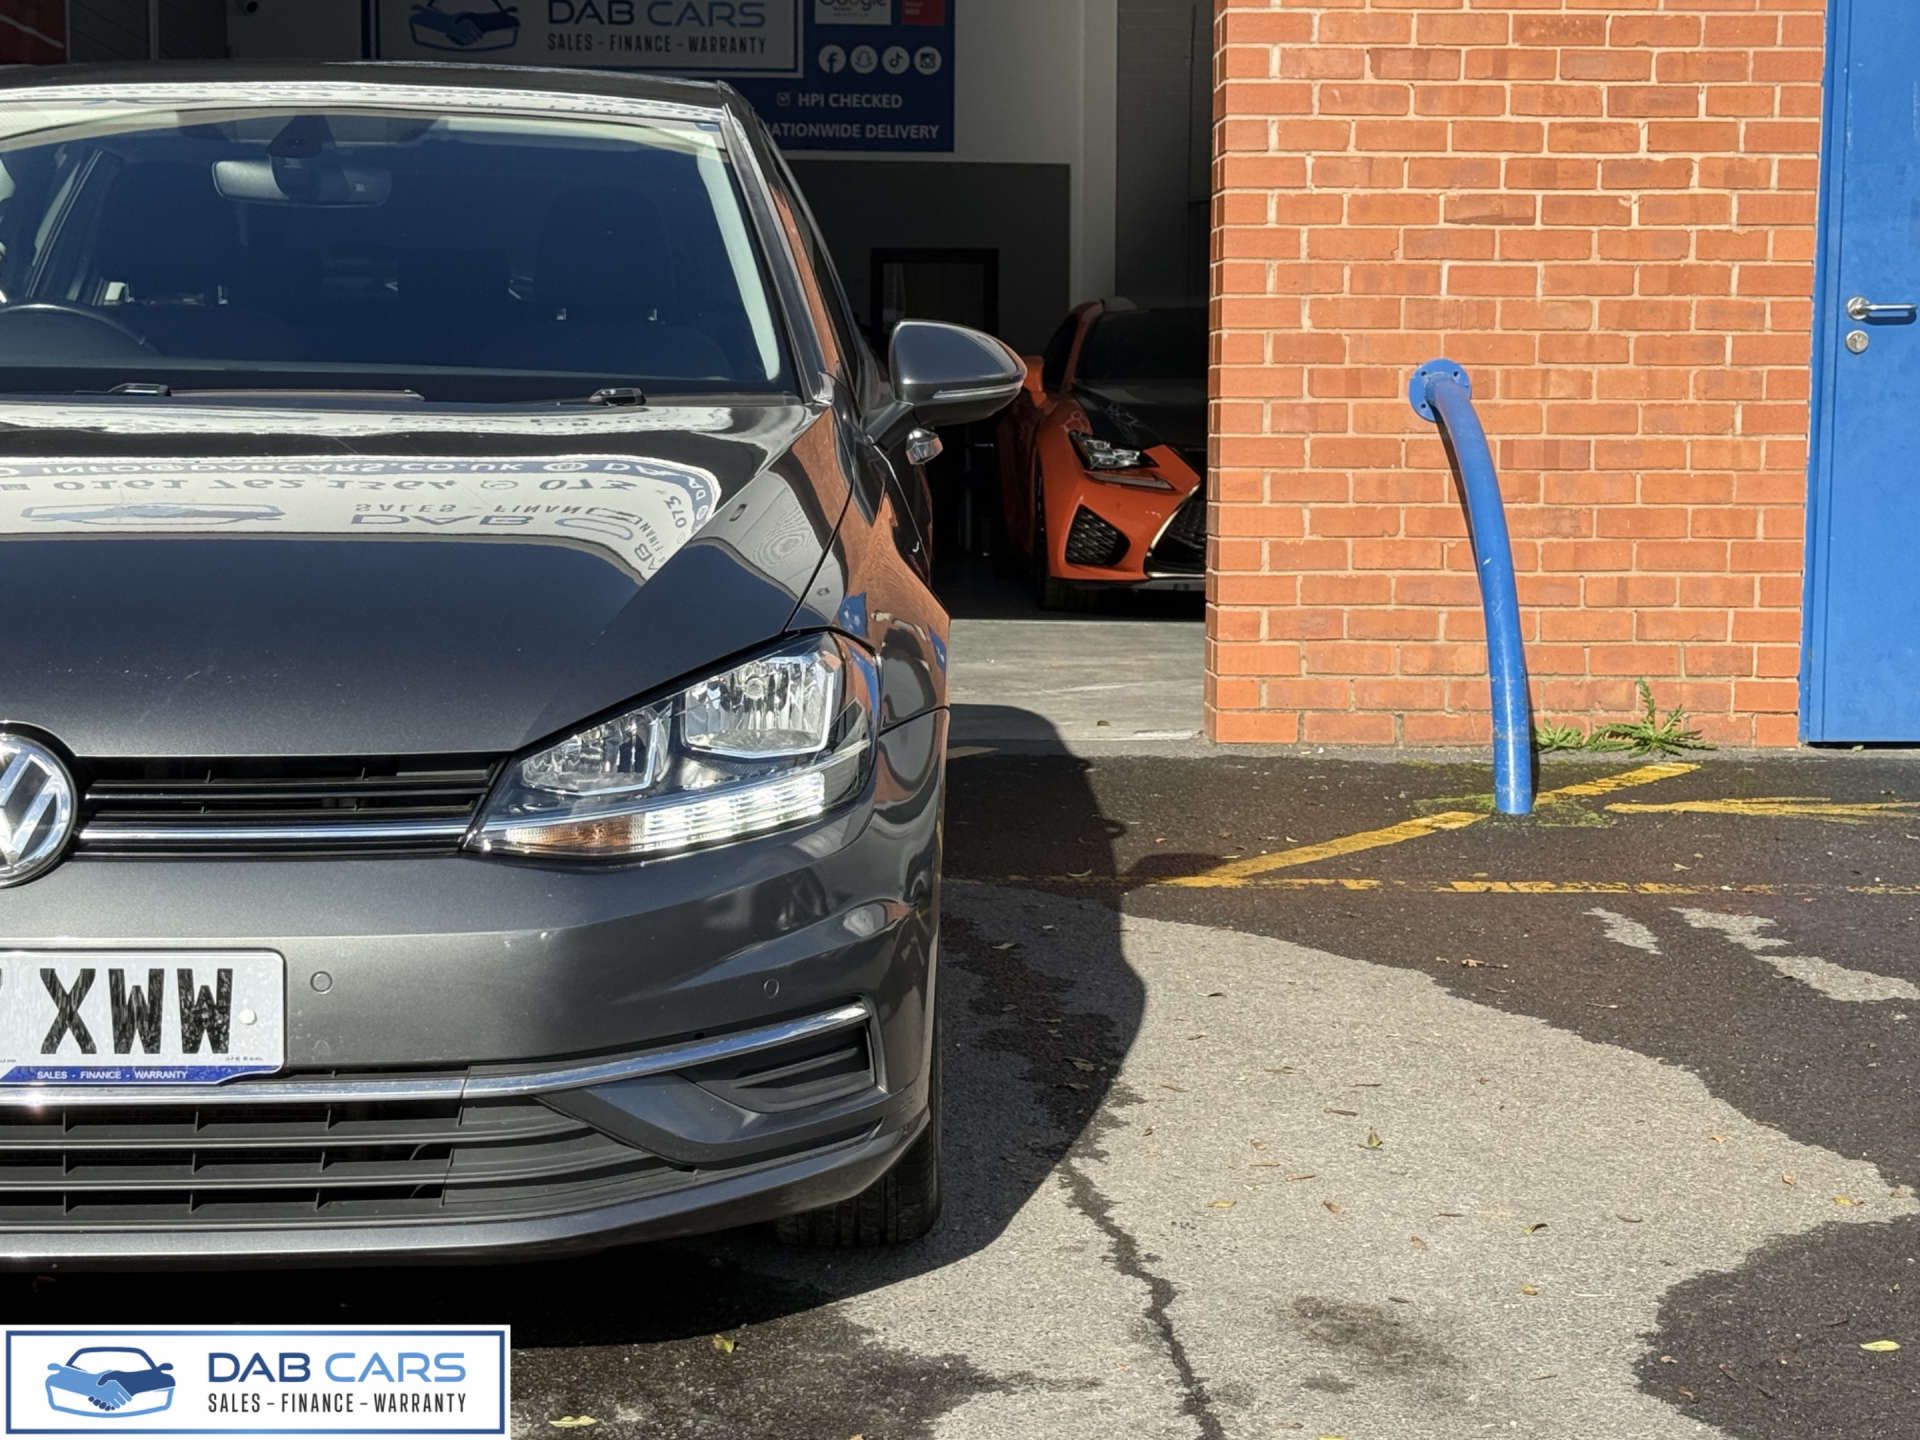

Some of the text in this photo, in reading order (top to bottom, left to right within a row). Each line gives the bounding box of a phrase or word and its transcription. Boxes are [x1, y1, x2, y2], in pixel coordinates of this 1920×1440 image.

[547, 0, 765, 27] DAB CARS
[547, 33, 593, 51] SALES
[609, 34, 671, 53] FINANCE
[688, 36, 766, 54] WARRANTY
[798, 93, 903, 109] HPI CHECKED
[769, 122, 940, 139] ATIONWIDE DELIVERY
[40, 968, 233, 1055] XWW
[36, 1070, 68, 1080] SALES
[80, 1070, 122, 1080] FINANCE
[134, 1070, 188, 1080] WARRANTY
